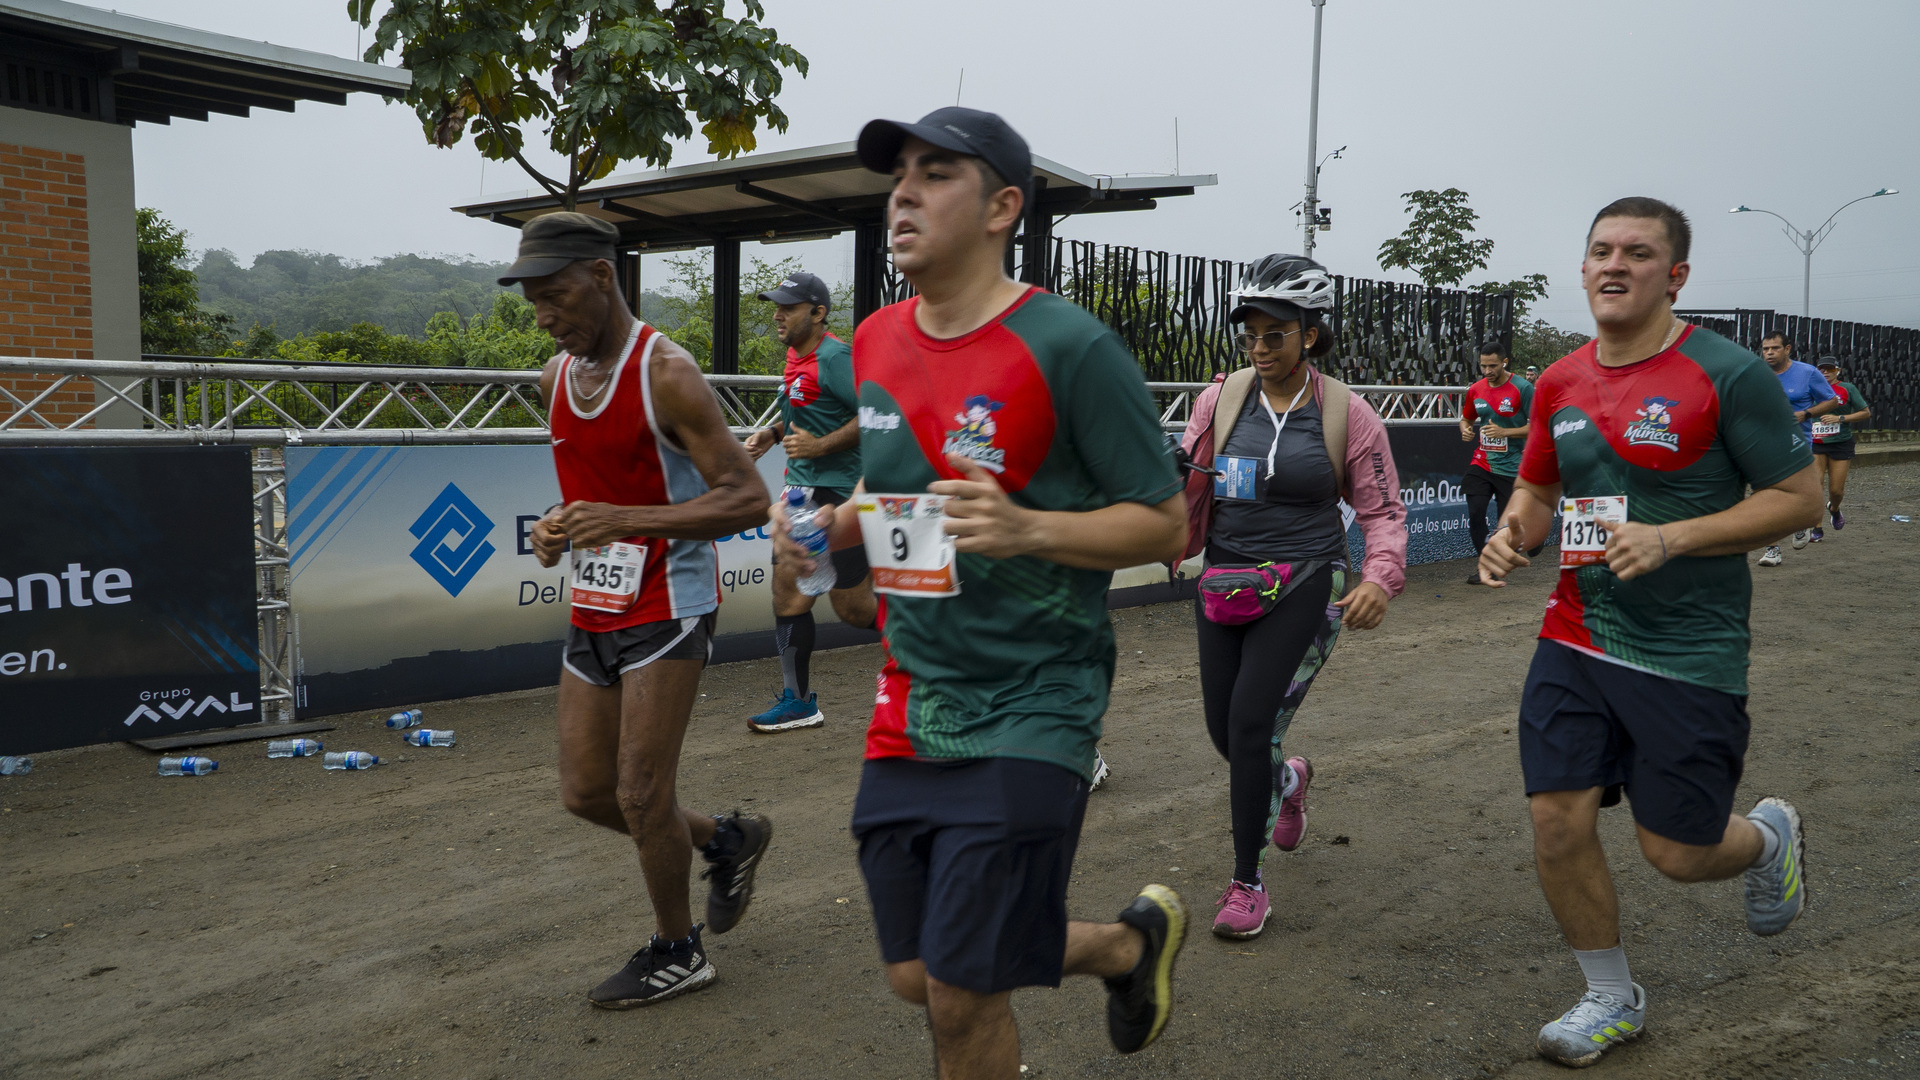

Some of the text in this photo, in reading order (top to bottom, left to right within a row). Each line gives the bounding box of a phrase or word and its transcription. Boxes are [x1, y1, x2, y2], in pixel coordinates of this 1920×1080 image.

[1623, 424, 1680, 444] Muñeca
[1417, 481, 1435, 505] de
[1411, 518, 1424, 534] de
[1426, 517, 1440, 532] los
[1442, 519, 1459, 534] que
[1564, 521, 1607, 546] 1376
[891, 527, 908, 562] 9
[518, 577, 564, 606] Del
[722, 568, 765, 593] que
[575, 560, 623, 589] 1435
[140, 688, 191, 701] Grupo
[123, 691, 253, 727] AVAL
